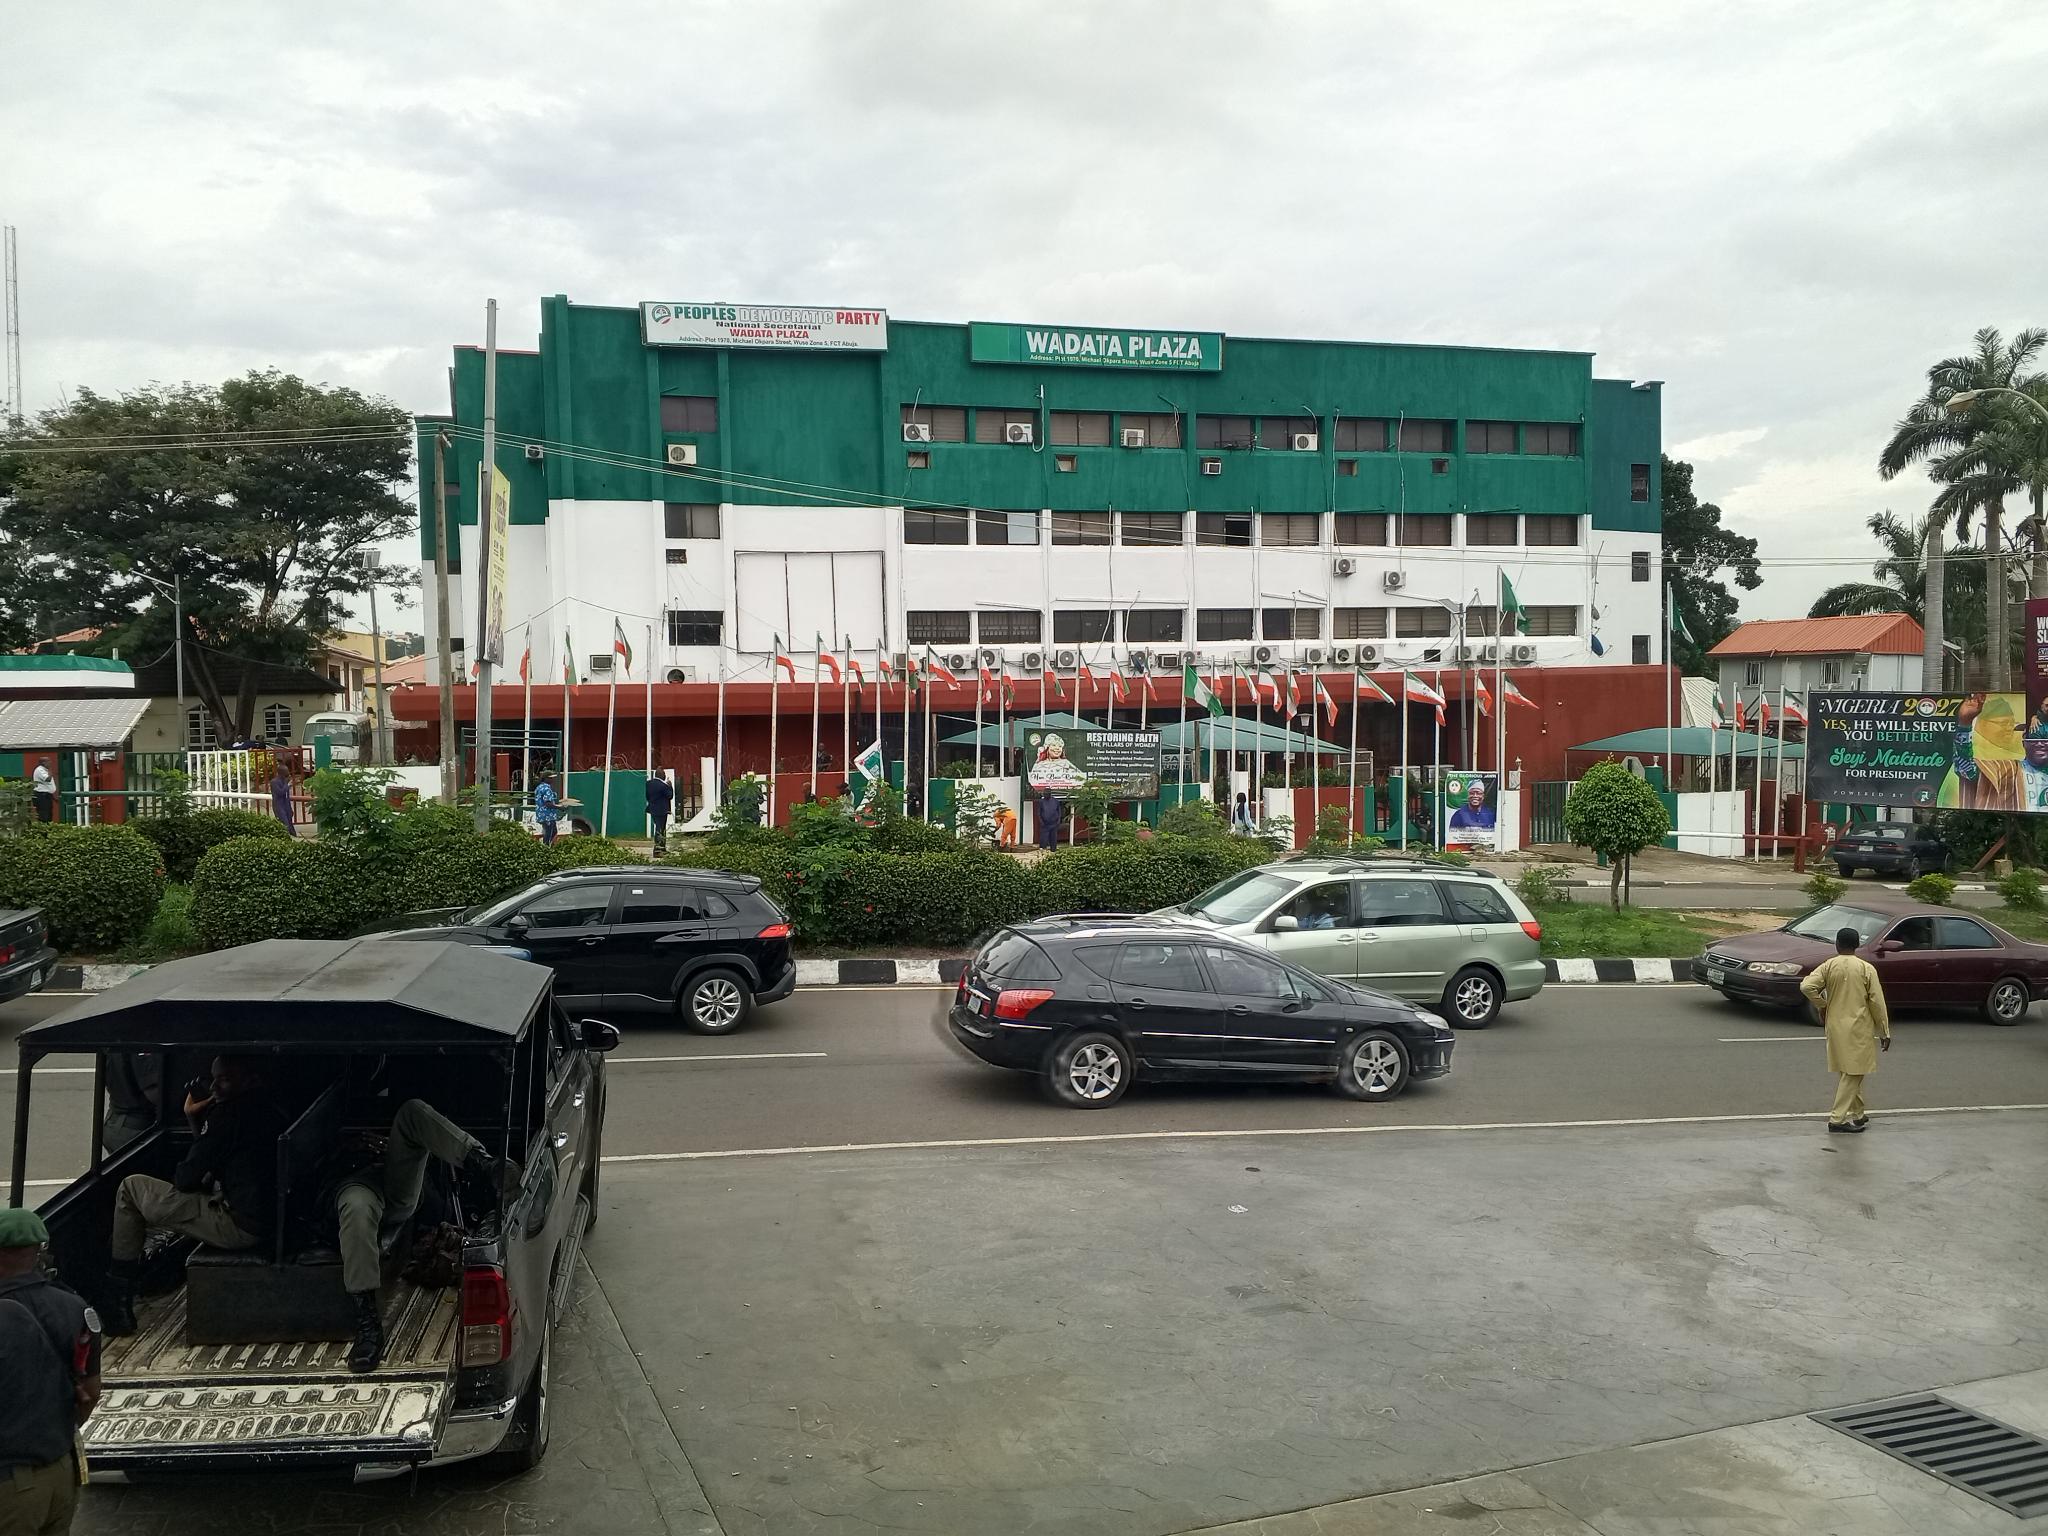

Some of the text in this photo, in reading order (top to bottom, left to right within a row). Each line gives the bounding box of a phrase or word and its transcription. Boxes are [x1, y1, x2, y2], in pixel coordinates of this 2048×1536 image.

[674, 306, 880, 325] PEOPLES DEMOCRATIC PARTY
[730, 328, 809, 339] WADATA PLAZA
[1026, 331, 1202, 360] WADATA PLAZA
[1818, 698, 1902, 715] NIGERIA
[1821, 718, 1956, 732] YES, HE WILL SERVE
[1086, 732, 1159, 742] RESTORING FAITH
[1843, 730, 1934, 743] YOU BETTER!
[1829, 748, 1946, 768] Seyi Makinde
[1845, 769, 1929, 780] FOR PRESIDENT
[1834, 790, 1884, 798] POWERED
